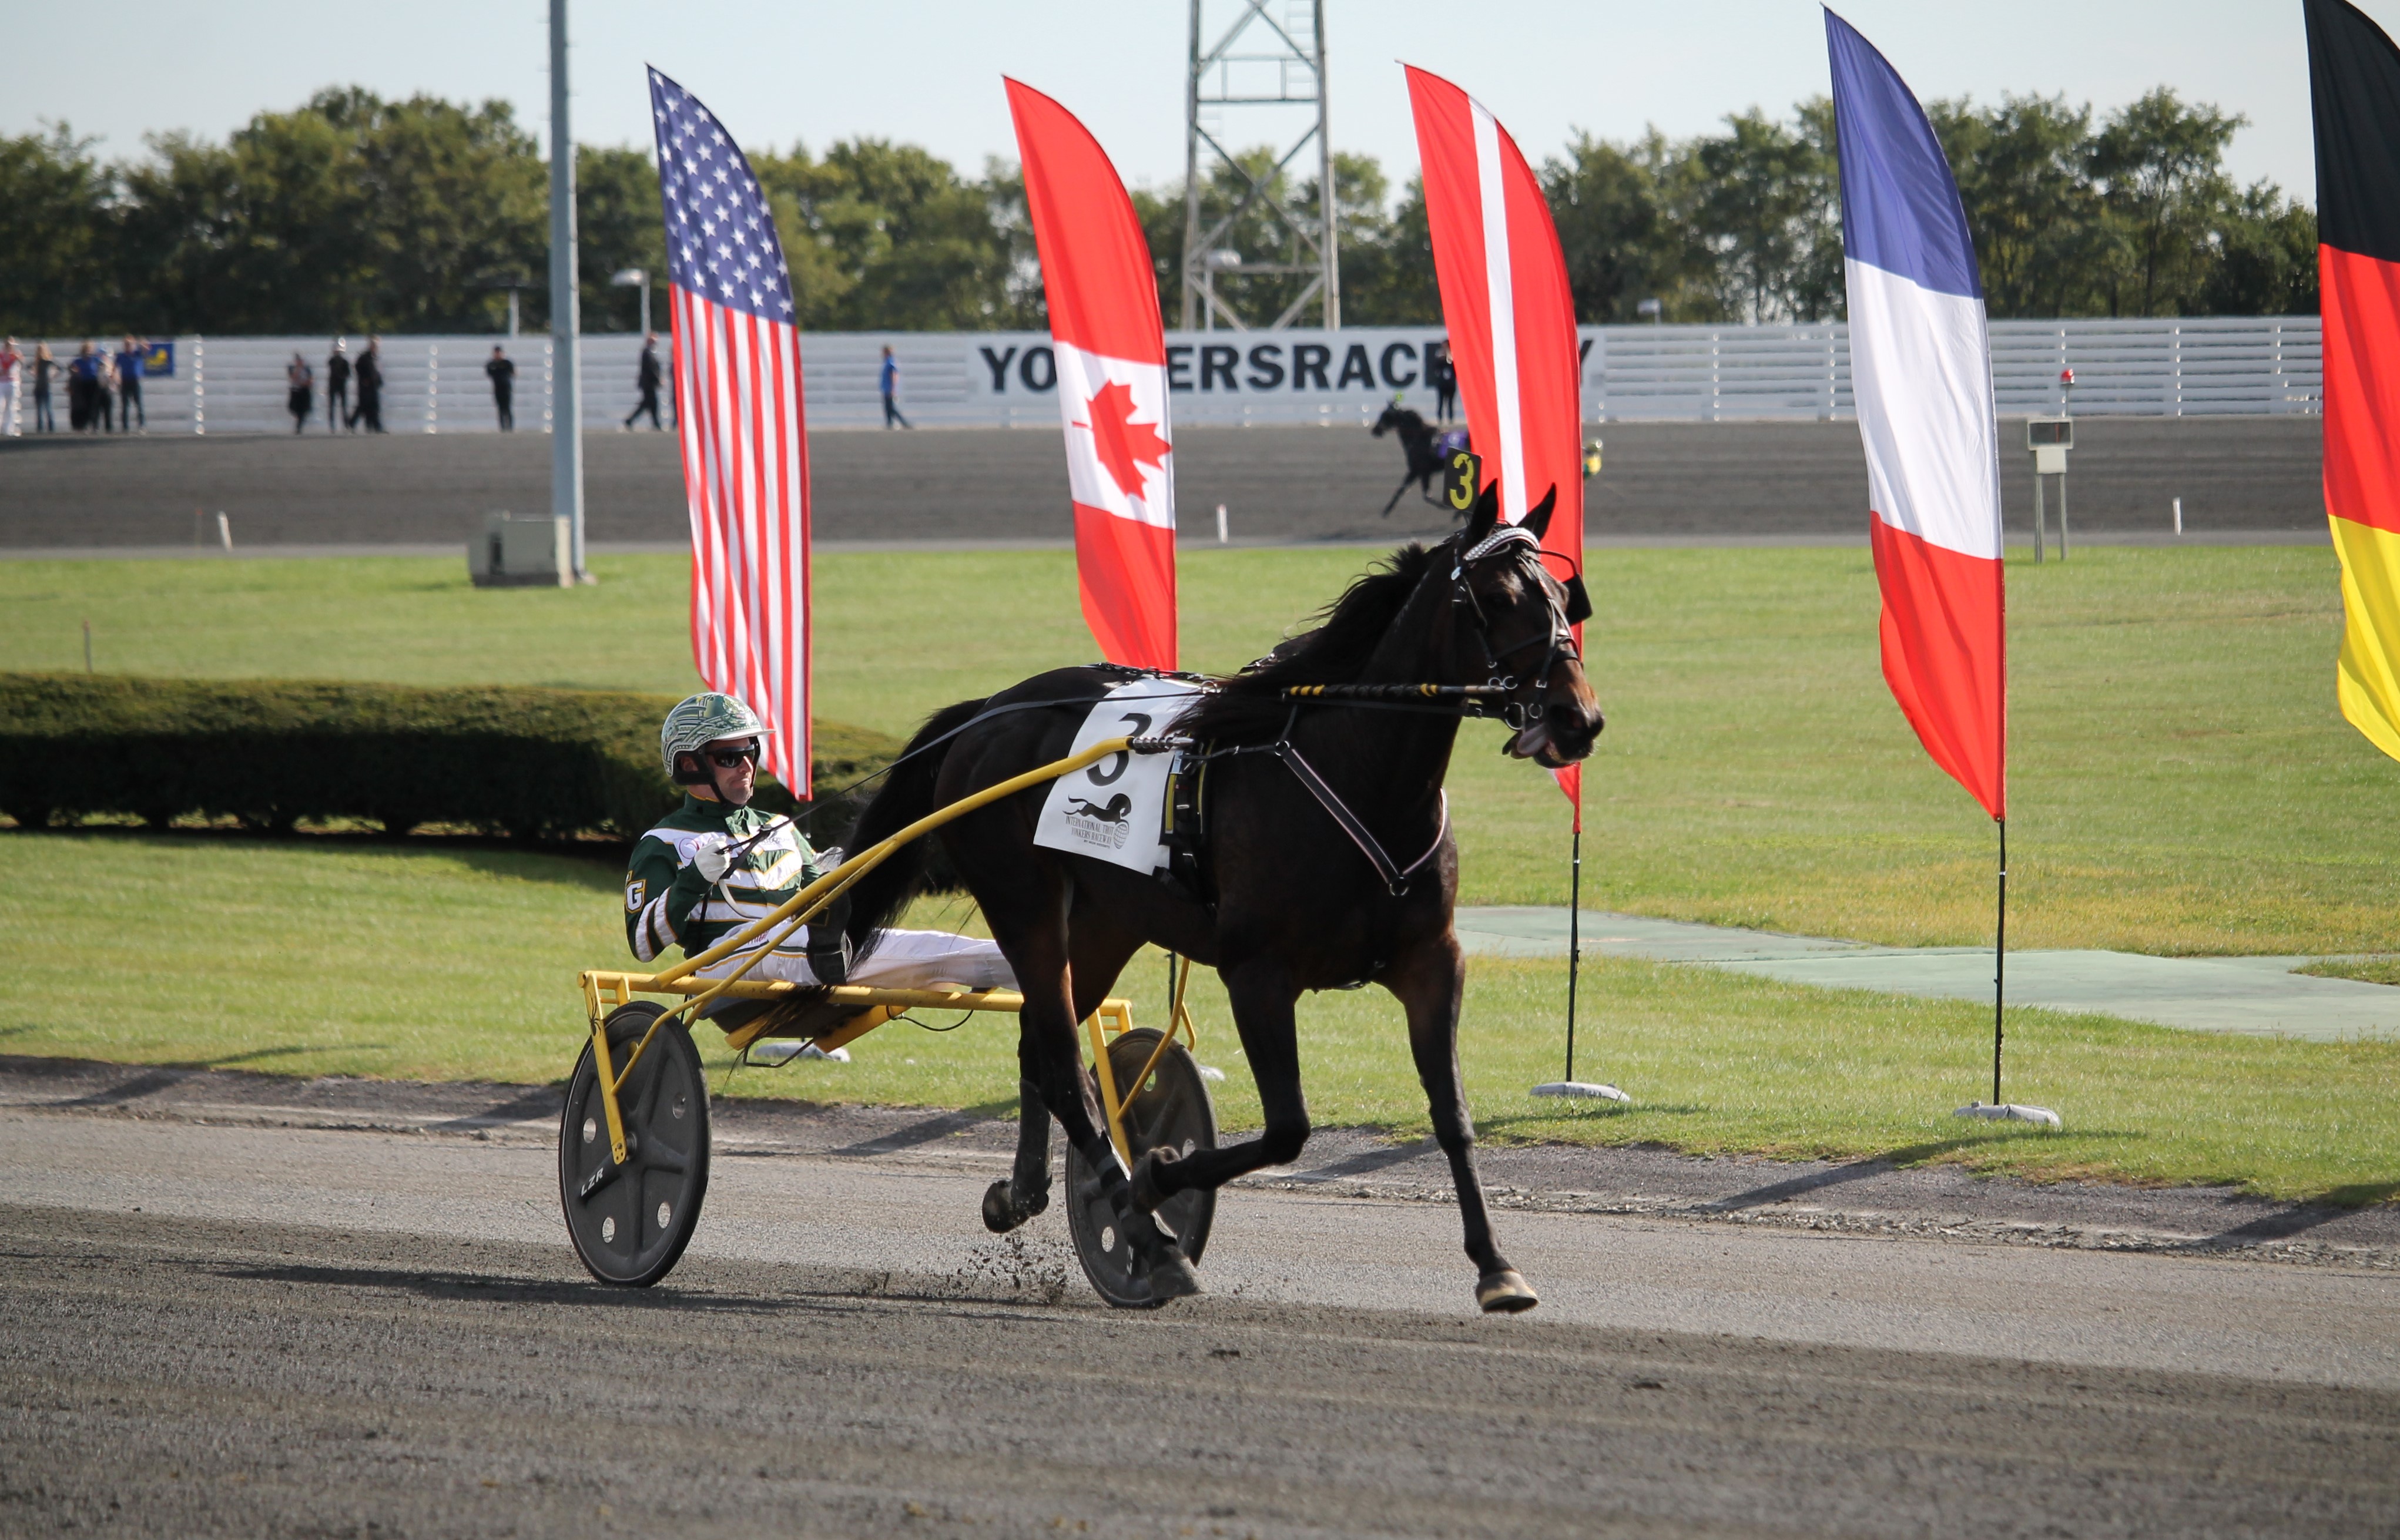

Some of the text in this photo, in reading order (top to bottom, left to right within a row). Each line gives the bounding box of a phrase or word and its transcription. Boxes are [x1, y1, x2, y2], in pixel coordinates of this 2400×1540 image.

[1449, 453, 1474, 510] 3
[1065, 816, 1114, 836] INTERNATIONAL TROT
[1091, 832, 1111, 844] RACEWAY
[626, 880, 644, 912] G
[581, 1167, 603, 1196] LZR
